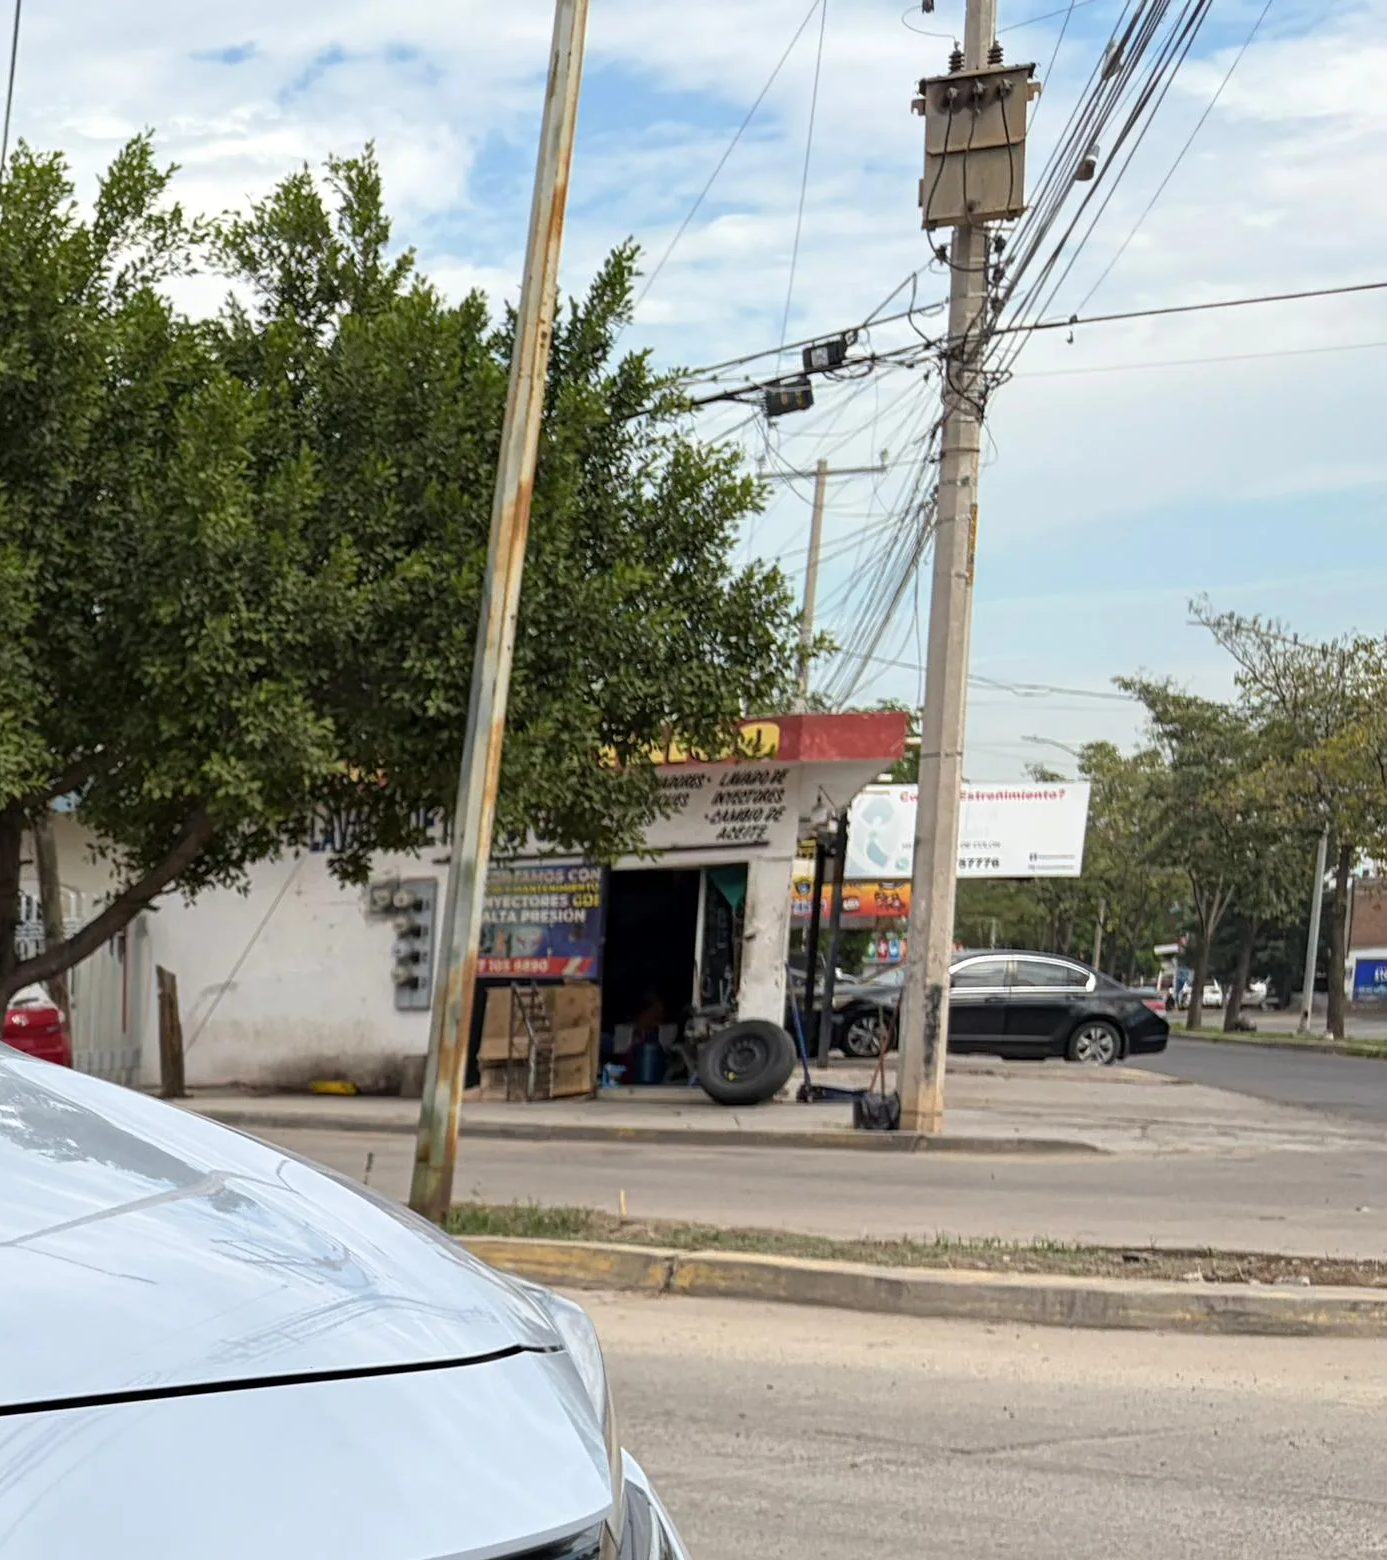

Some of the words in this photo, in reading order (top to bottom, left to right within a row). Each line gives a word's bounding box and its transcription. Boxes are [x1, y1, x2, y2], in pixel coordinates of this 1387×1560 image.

[719, 769, 770, 787] LAVADO
[770, 768, 789, 785] DE
[711, 787, 785, 806] INYECTORES
[710, 807, 764, 825] CAMBIO
[765, 805, 786, 822] DE
[715, 824, 768, 841] ACEITE
[568, 866, 602, 882] CON
[484, 894, 569, 908] NYECTORES
[572, 893, 600, 908] GDI
[482, 909, 516, 923] ALTA
[520, 907, 587, 923] PRESIÓN
